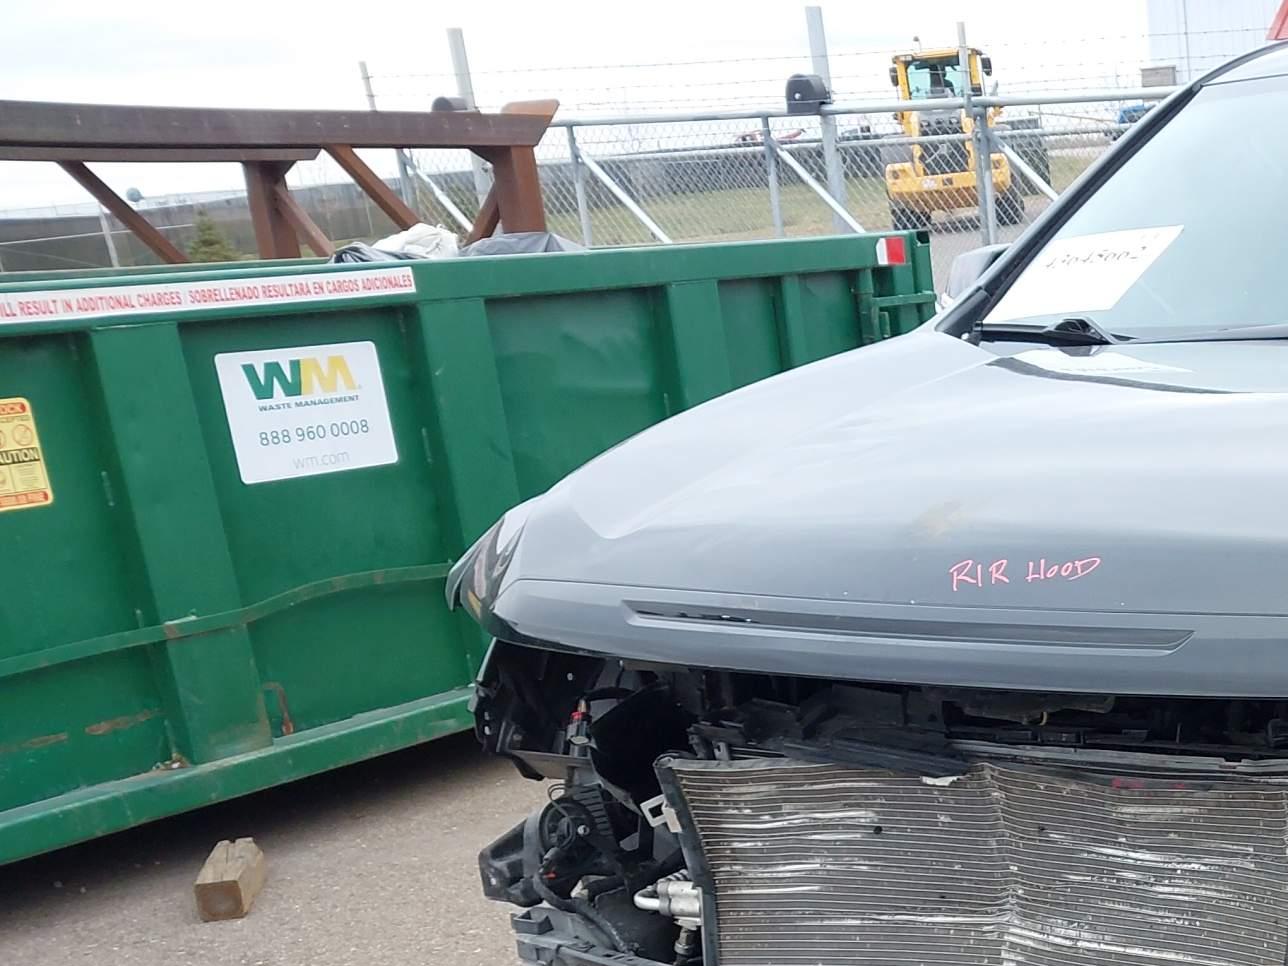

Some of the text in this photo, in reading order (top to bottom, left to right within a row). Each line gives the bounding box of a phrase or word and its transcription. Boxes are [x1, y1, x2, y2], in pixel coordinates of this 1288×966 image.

[19, 300, 58, 316] RESULT
[62, 299, 73, 313] IN
[76, 295, 135, 312] ADDITIONAL
[137, 291, 182, 308] CHARGES
[188, 286, 259, 304] SOBRELLENADO
[313, 280, 325, 294] EN
[326, 278, 360, 294] CARGOS
[361, 274, 413, 292] ADICIONALES
[241, 355, 358, 400] WM
[258, 395, 359, 412] WASTE MANAGEMENT
[259, 419, 369, 446] 888 960 0008
[293, 451, 350, 470] wm.com
